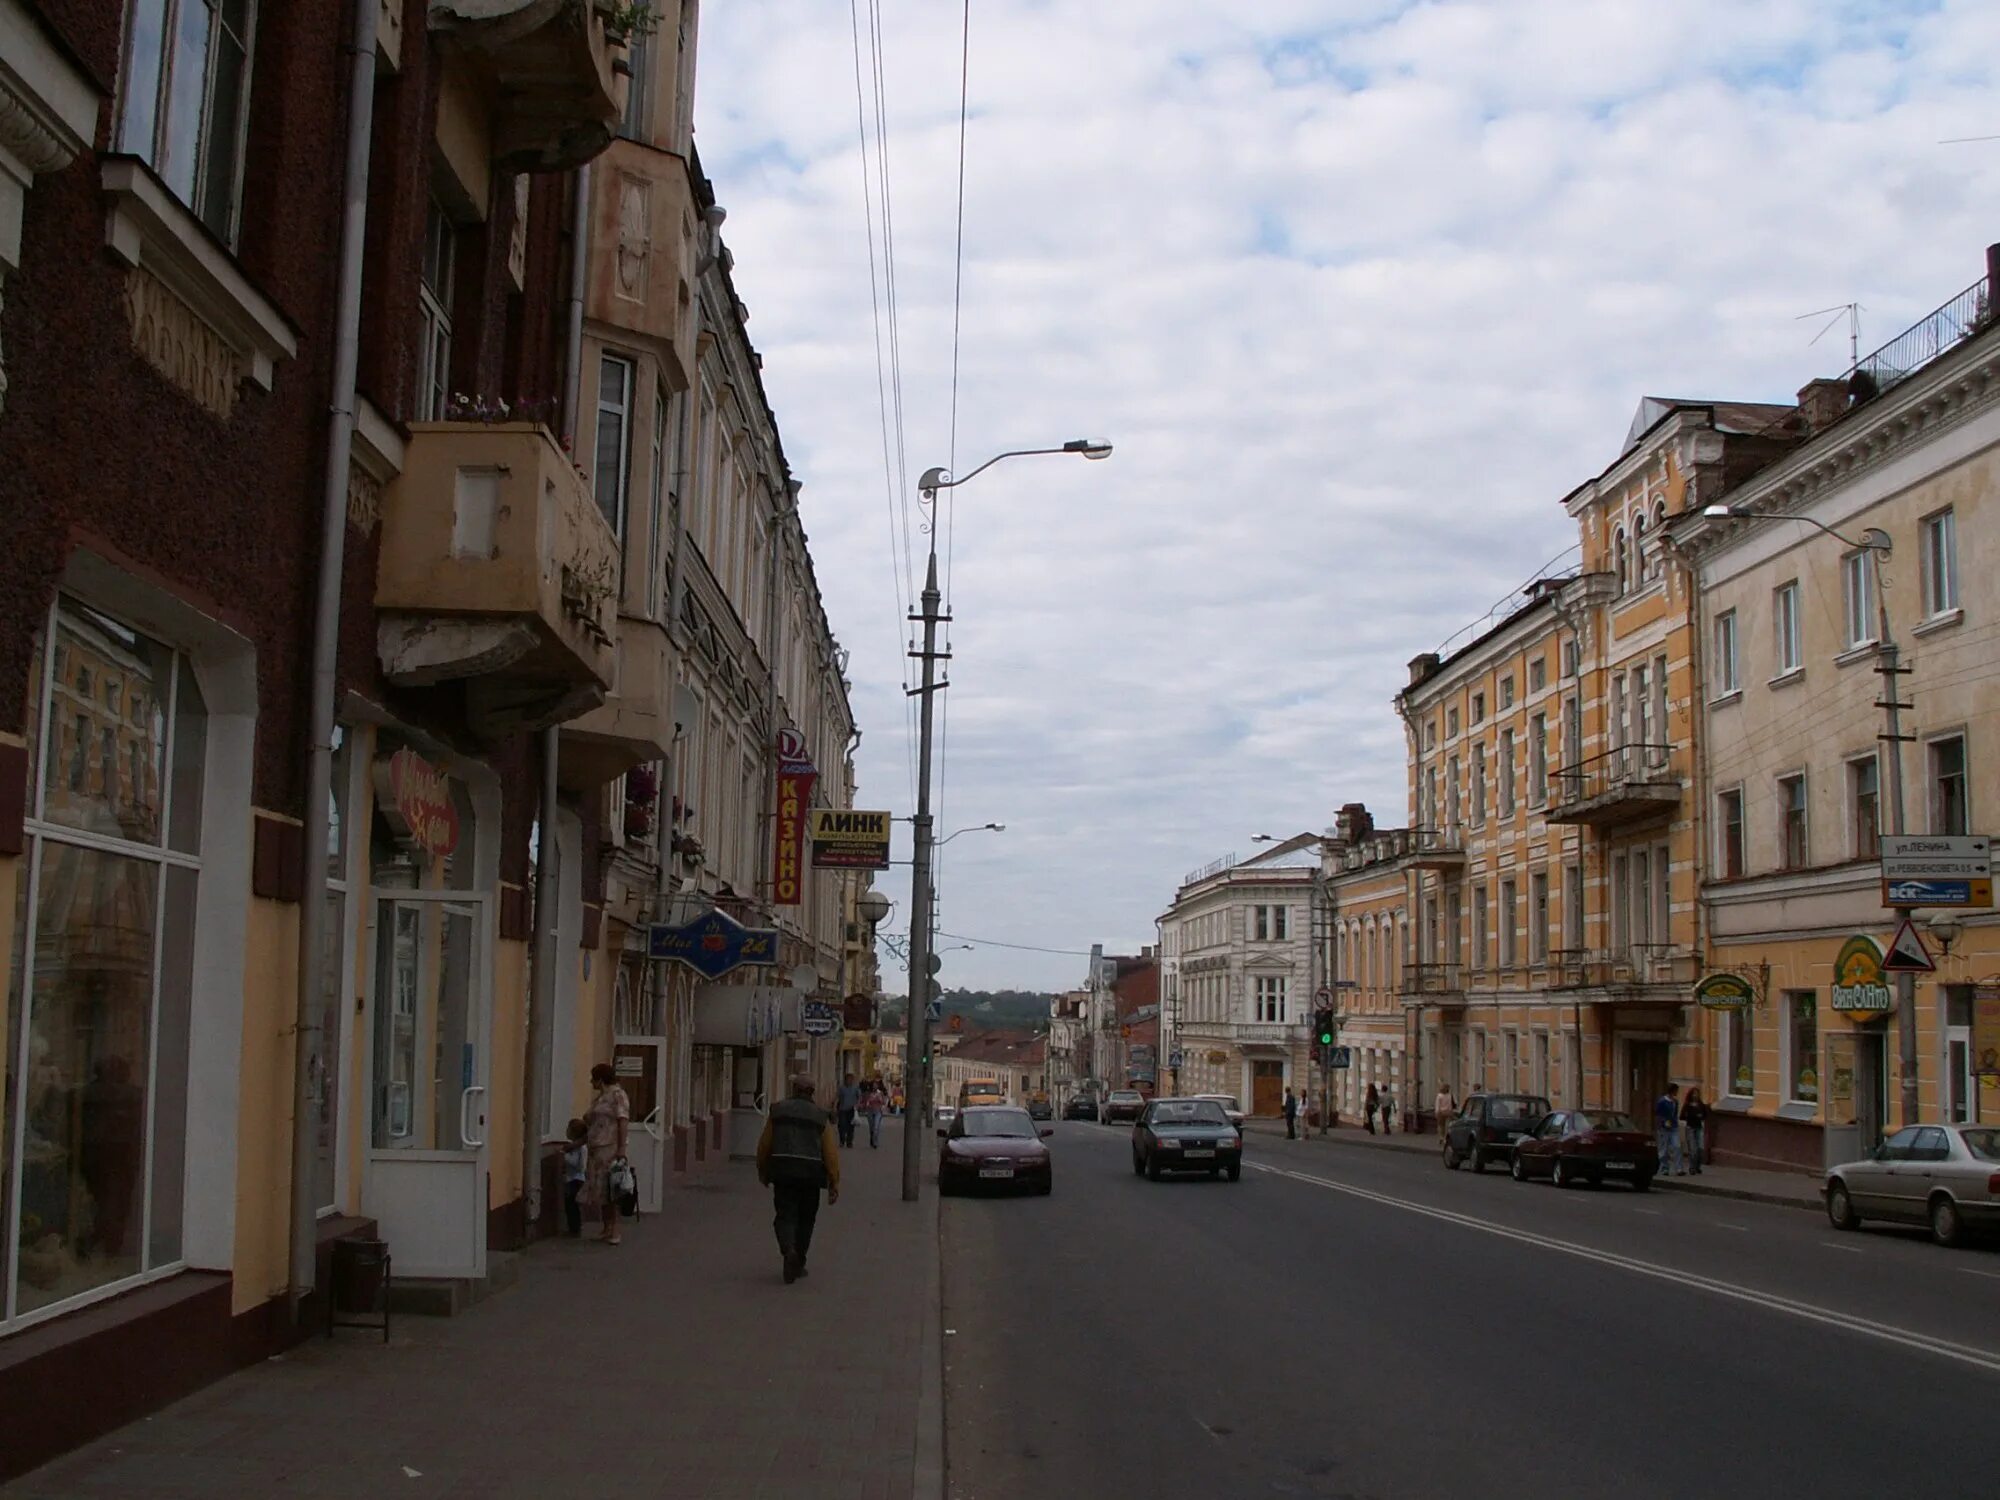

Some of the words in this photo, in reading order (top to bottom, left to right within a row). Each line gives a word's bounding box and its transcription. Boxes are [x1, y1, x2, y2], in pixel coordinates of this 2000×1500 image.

[818, 813, 884, 833] ЛИНК
[778, 779, 799, 899] КАЗИНО
[1888, 887, 1917, 899] ВСК
